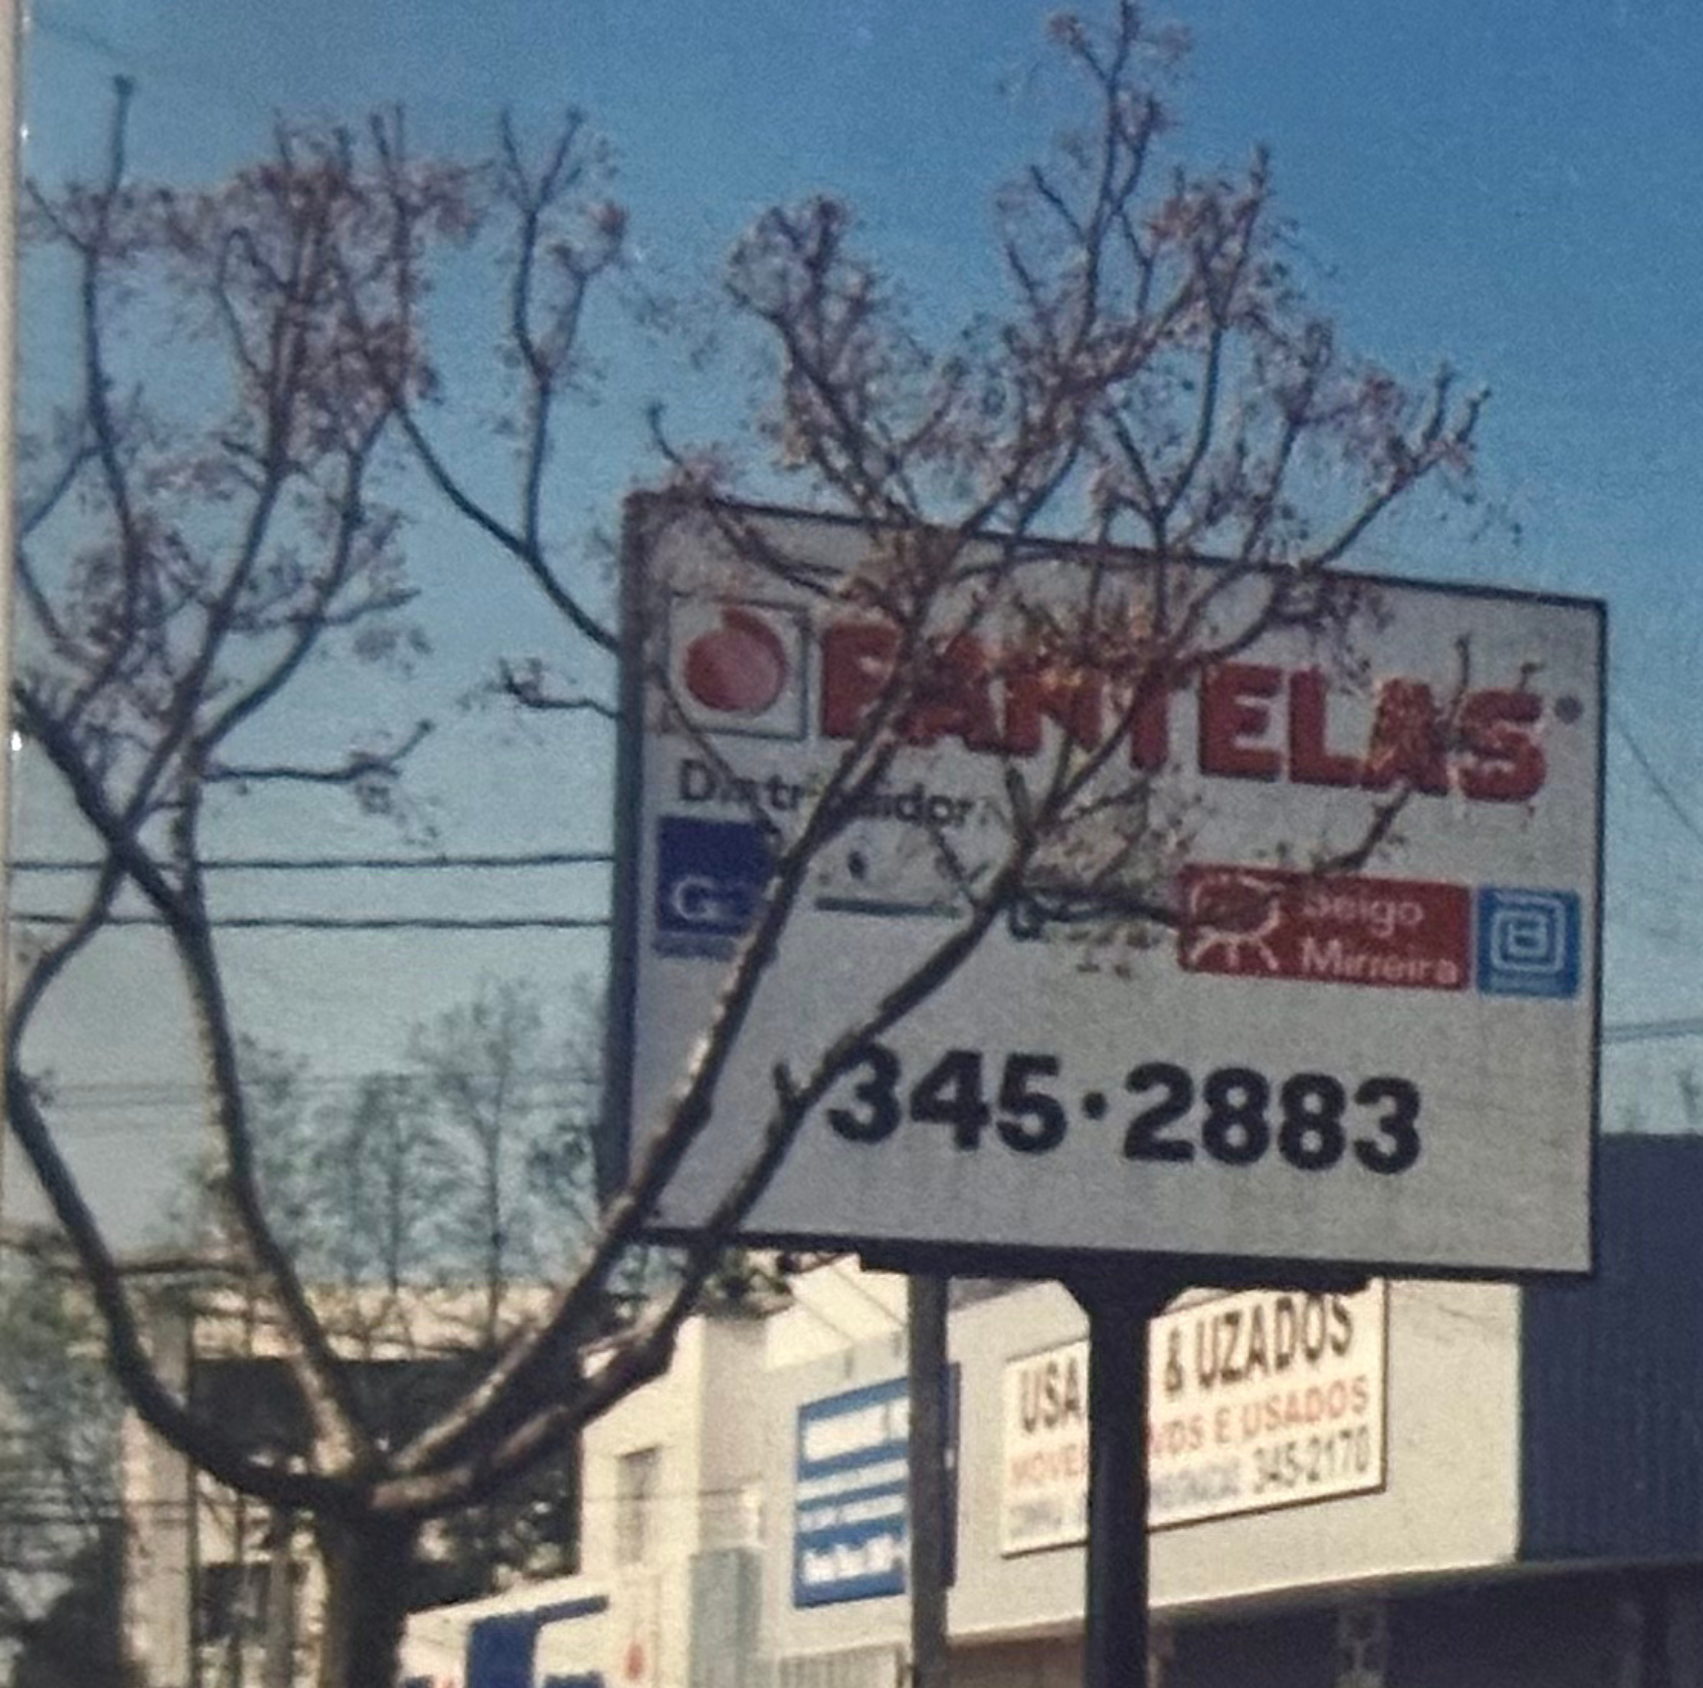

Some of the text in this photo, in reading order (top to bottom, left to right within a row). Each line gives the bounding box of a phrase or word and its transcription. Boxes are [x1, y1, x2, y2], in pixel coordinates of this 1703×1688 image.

[1019, 1355, 1084, 1433] USA
[1197, 1294, 1355, 1390] UZADOS
[1242, 1374, 1369, 1440] USADOS
